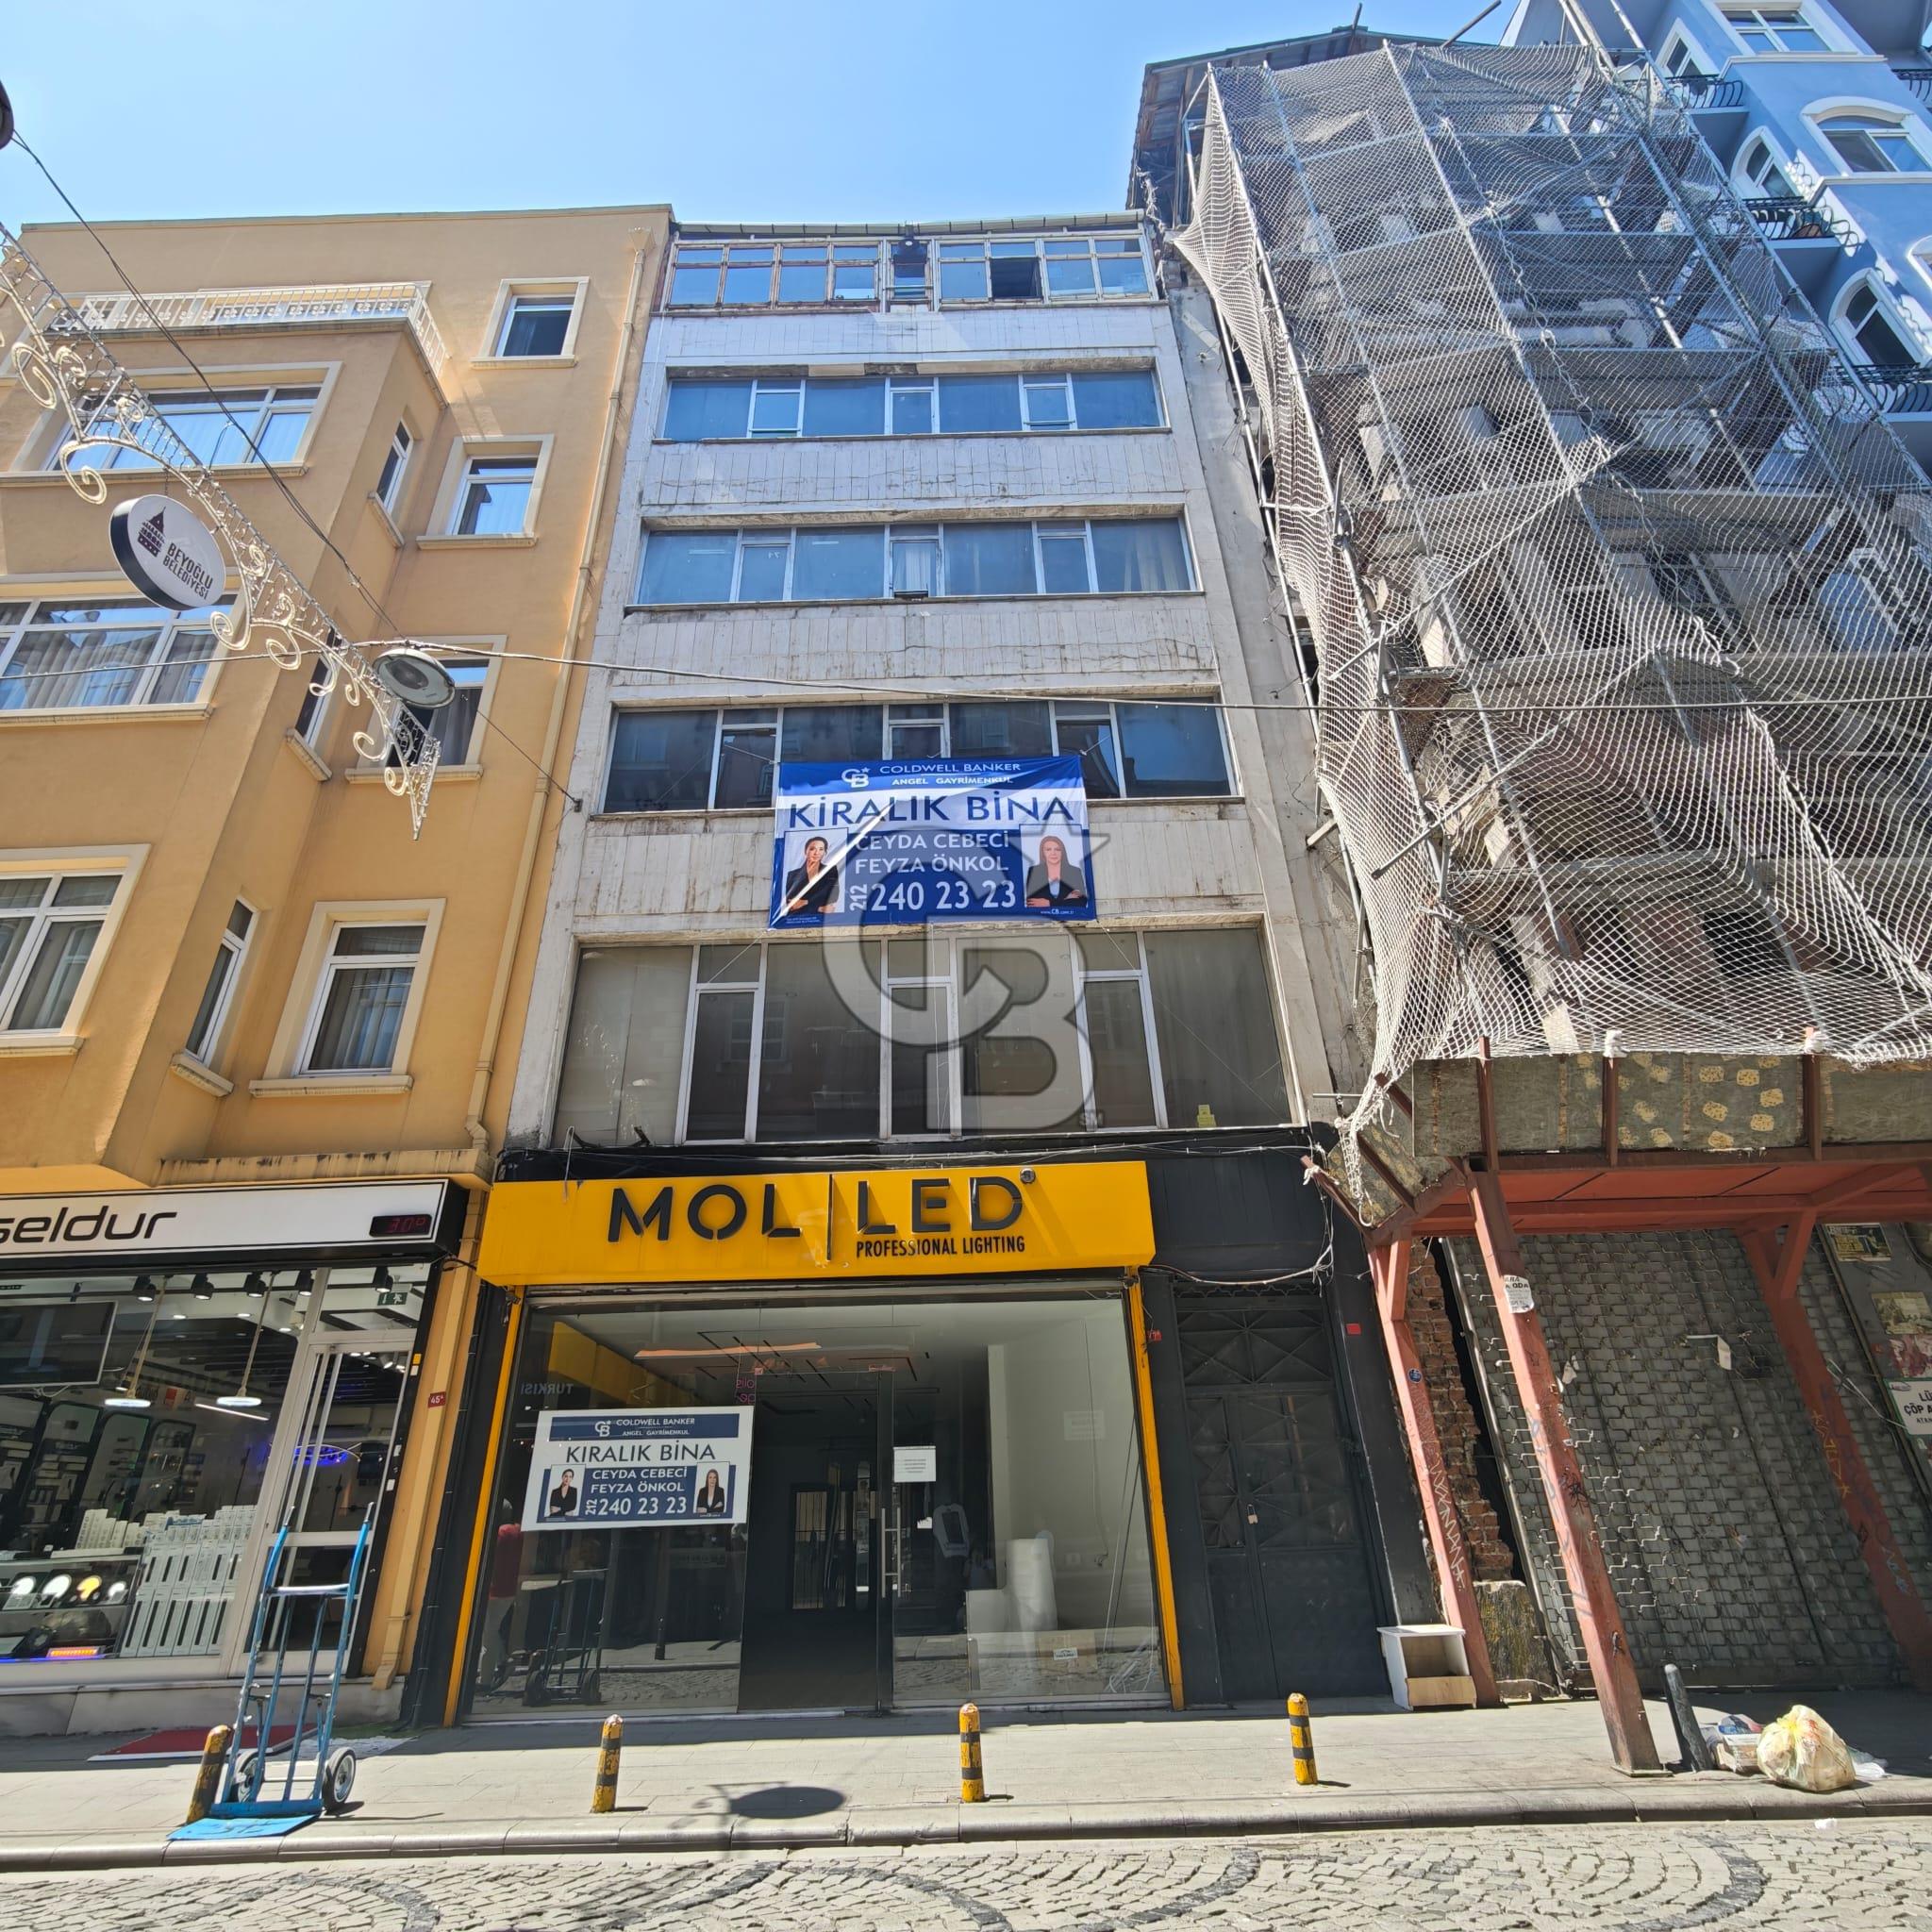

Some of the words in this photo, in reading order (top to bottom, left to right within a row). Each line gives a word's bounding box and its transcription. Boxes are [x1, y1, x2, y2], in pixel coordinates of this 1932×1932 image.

[167, 542, 213, 590] BEYOĞLU
[879, 764, 959, 774] COLDWELL
[963, 763, 1021, 773] BANKER
[891, 777, 928, 786] ANGEL
[935, 775, 1014, 786] GAYRİMENKUL
[789, 795, 950, 828] KİRALIK
[967, 791, 1074, 822] BİNA
[856, 834, 927, 851] CEYDA
[933, 830, 1009, 849] CEBECİ
[855, 857, 924, 874] FEYZA
[931, 852, 1008, 873] ÖNKOL
[850, 884, 868, 911] 212
[871, 881, 924, 911] 240
[936, 881, 970, 909] 23
[981, 880, 1016, 908] 23
[608, 1183, 801, 1242] MOL
[857, 1176, 1023, 1235] LED
[857, 1239, 958, 1258] PROFESSIONAL
[962, 1236, 1025, 1254] LIGHTING
[1904, 1402, 1924, 1416] ÇÖP
[616, 1418, 660, 1426] COLDWELL
[659, 1440, 716, 1461] BİNA
[592, 1469, 637, 1480] CEYDA
[641, 1466, 688, 1478] CEBECİ
[591, 1483, 634, 1494] FEYZA
[637, 1480, 685, 1492] ÖNKOL
[585, 1499, 598, 1515] 212
[598, 1497, 632, 1516] 240
[638, 1497, 658, 1515] 23
[665, 1496, 687, 1514] 23
